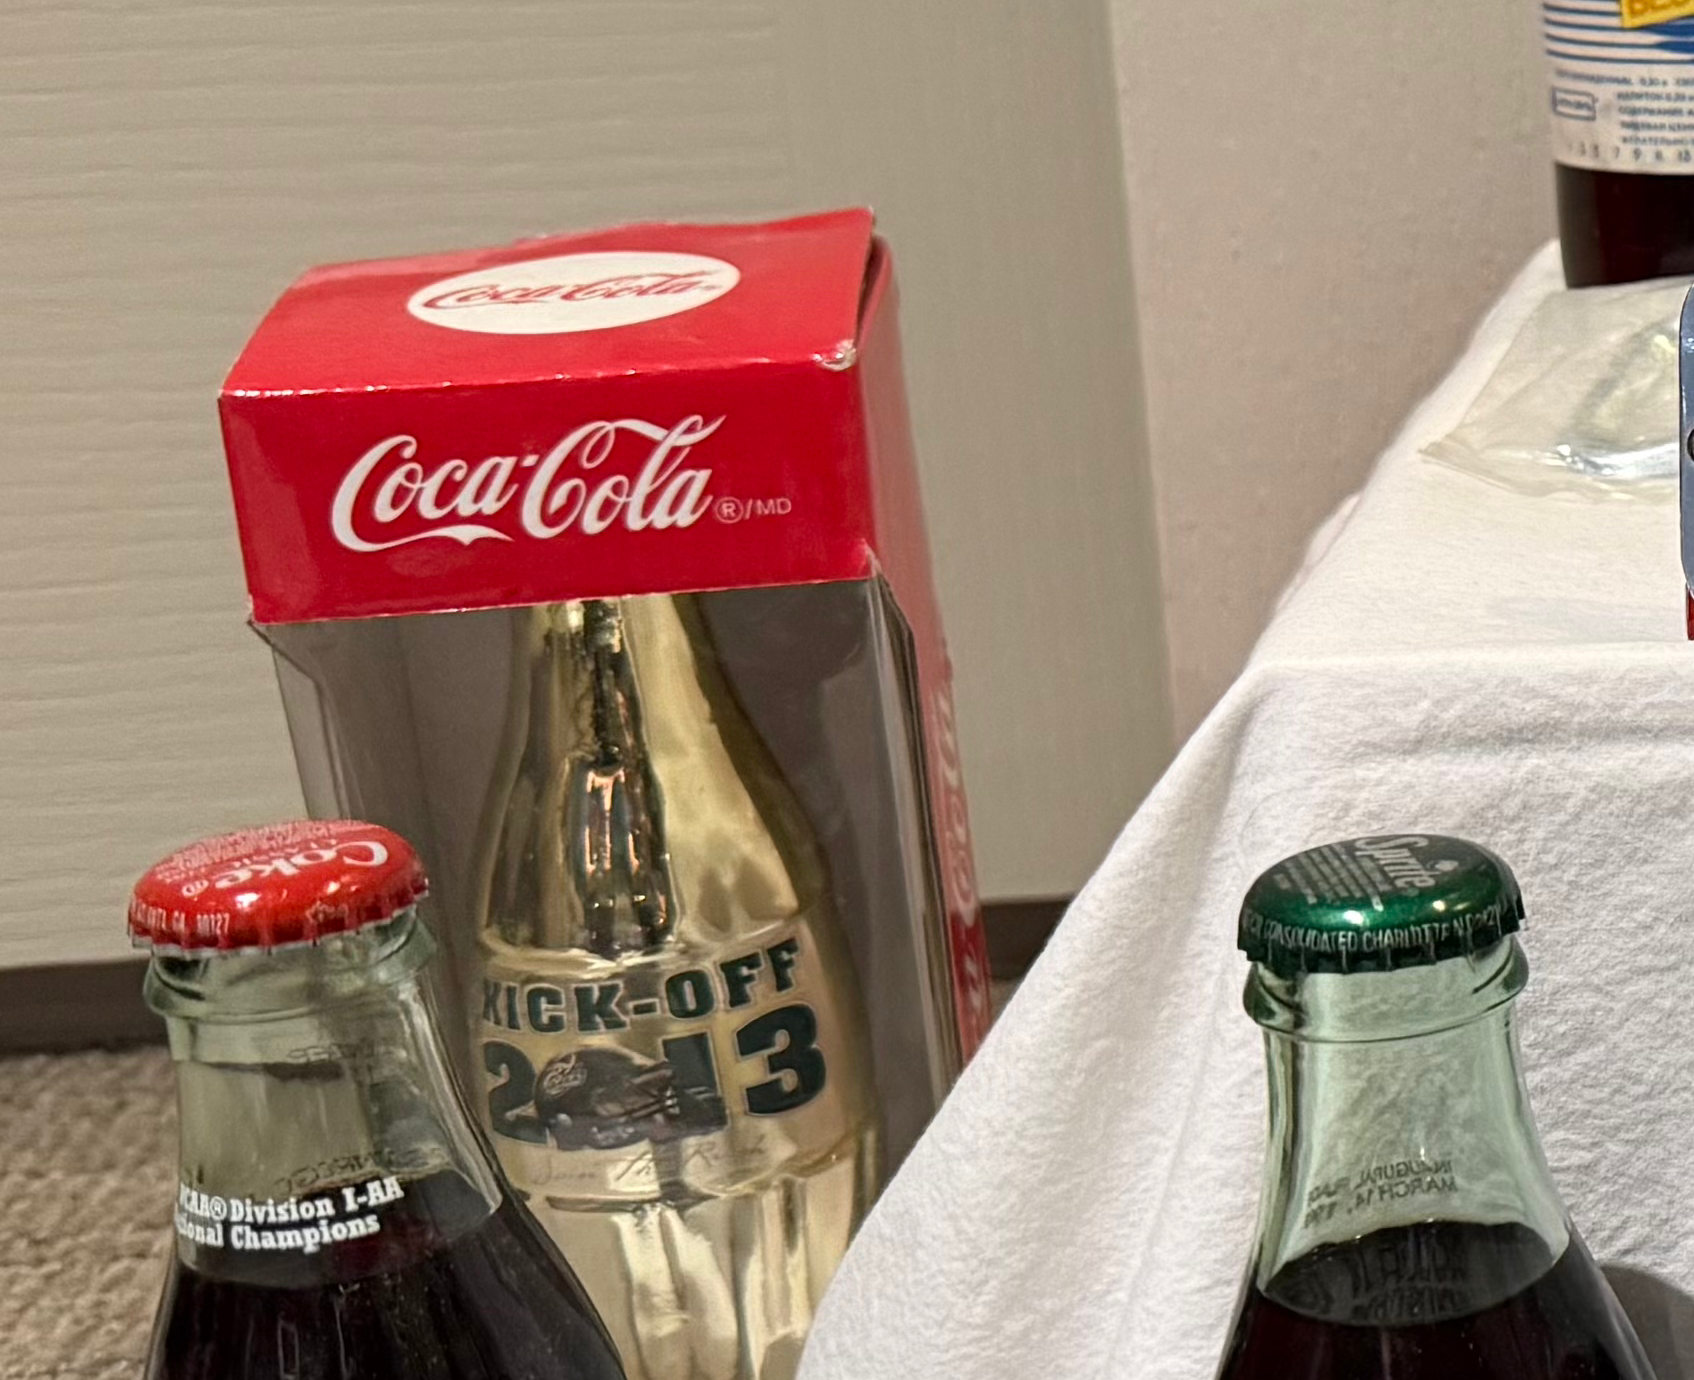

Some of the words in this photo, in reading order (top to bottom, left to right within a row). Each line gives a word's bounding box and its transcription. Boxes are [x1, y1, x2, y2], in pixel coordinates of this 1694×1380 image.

[422, 270, 722, 310] Coca-Cola
[331, 415, 727, 552] Coca-Cola
[215, 840, 388, 889] Coke
[1354, 836, 1436, 889] Sprite
[482, 936, 800, 1034] KICK-OFF
[483, 1002, 827, 1146] 213
[230, 1196, 335, 1224] Division
[342, 1176, 405, 1212] I-AA
[229, 1214, 381, 1255] Champions
